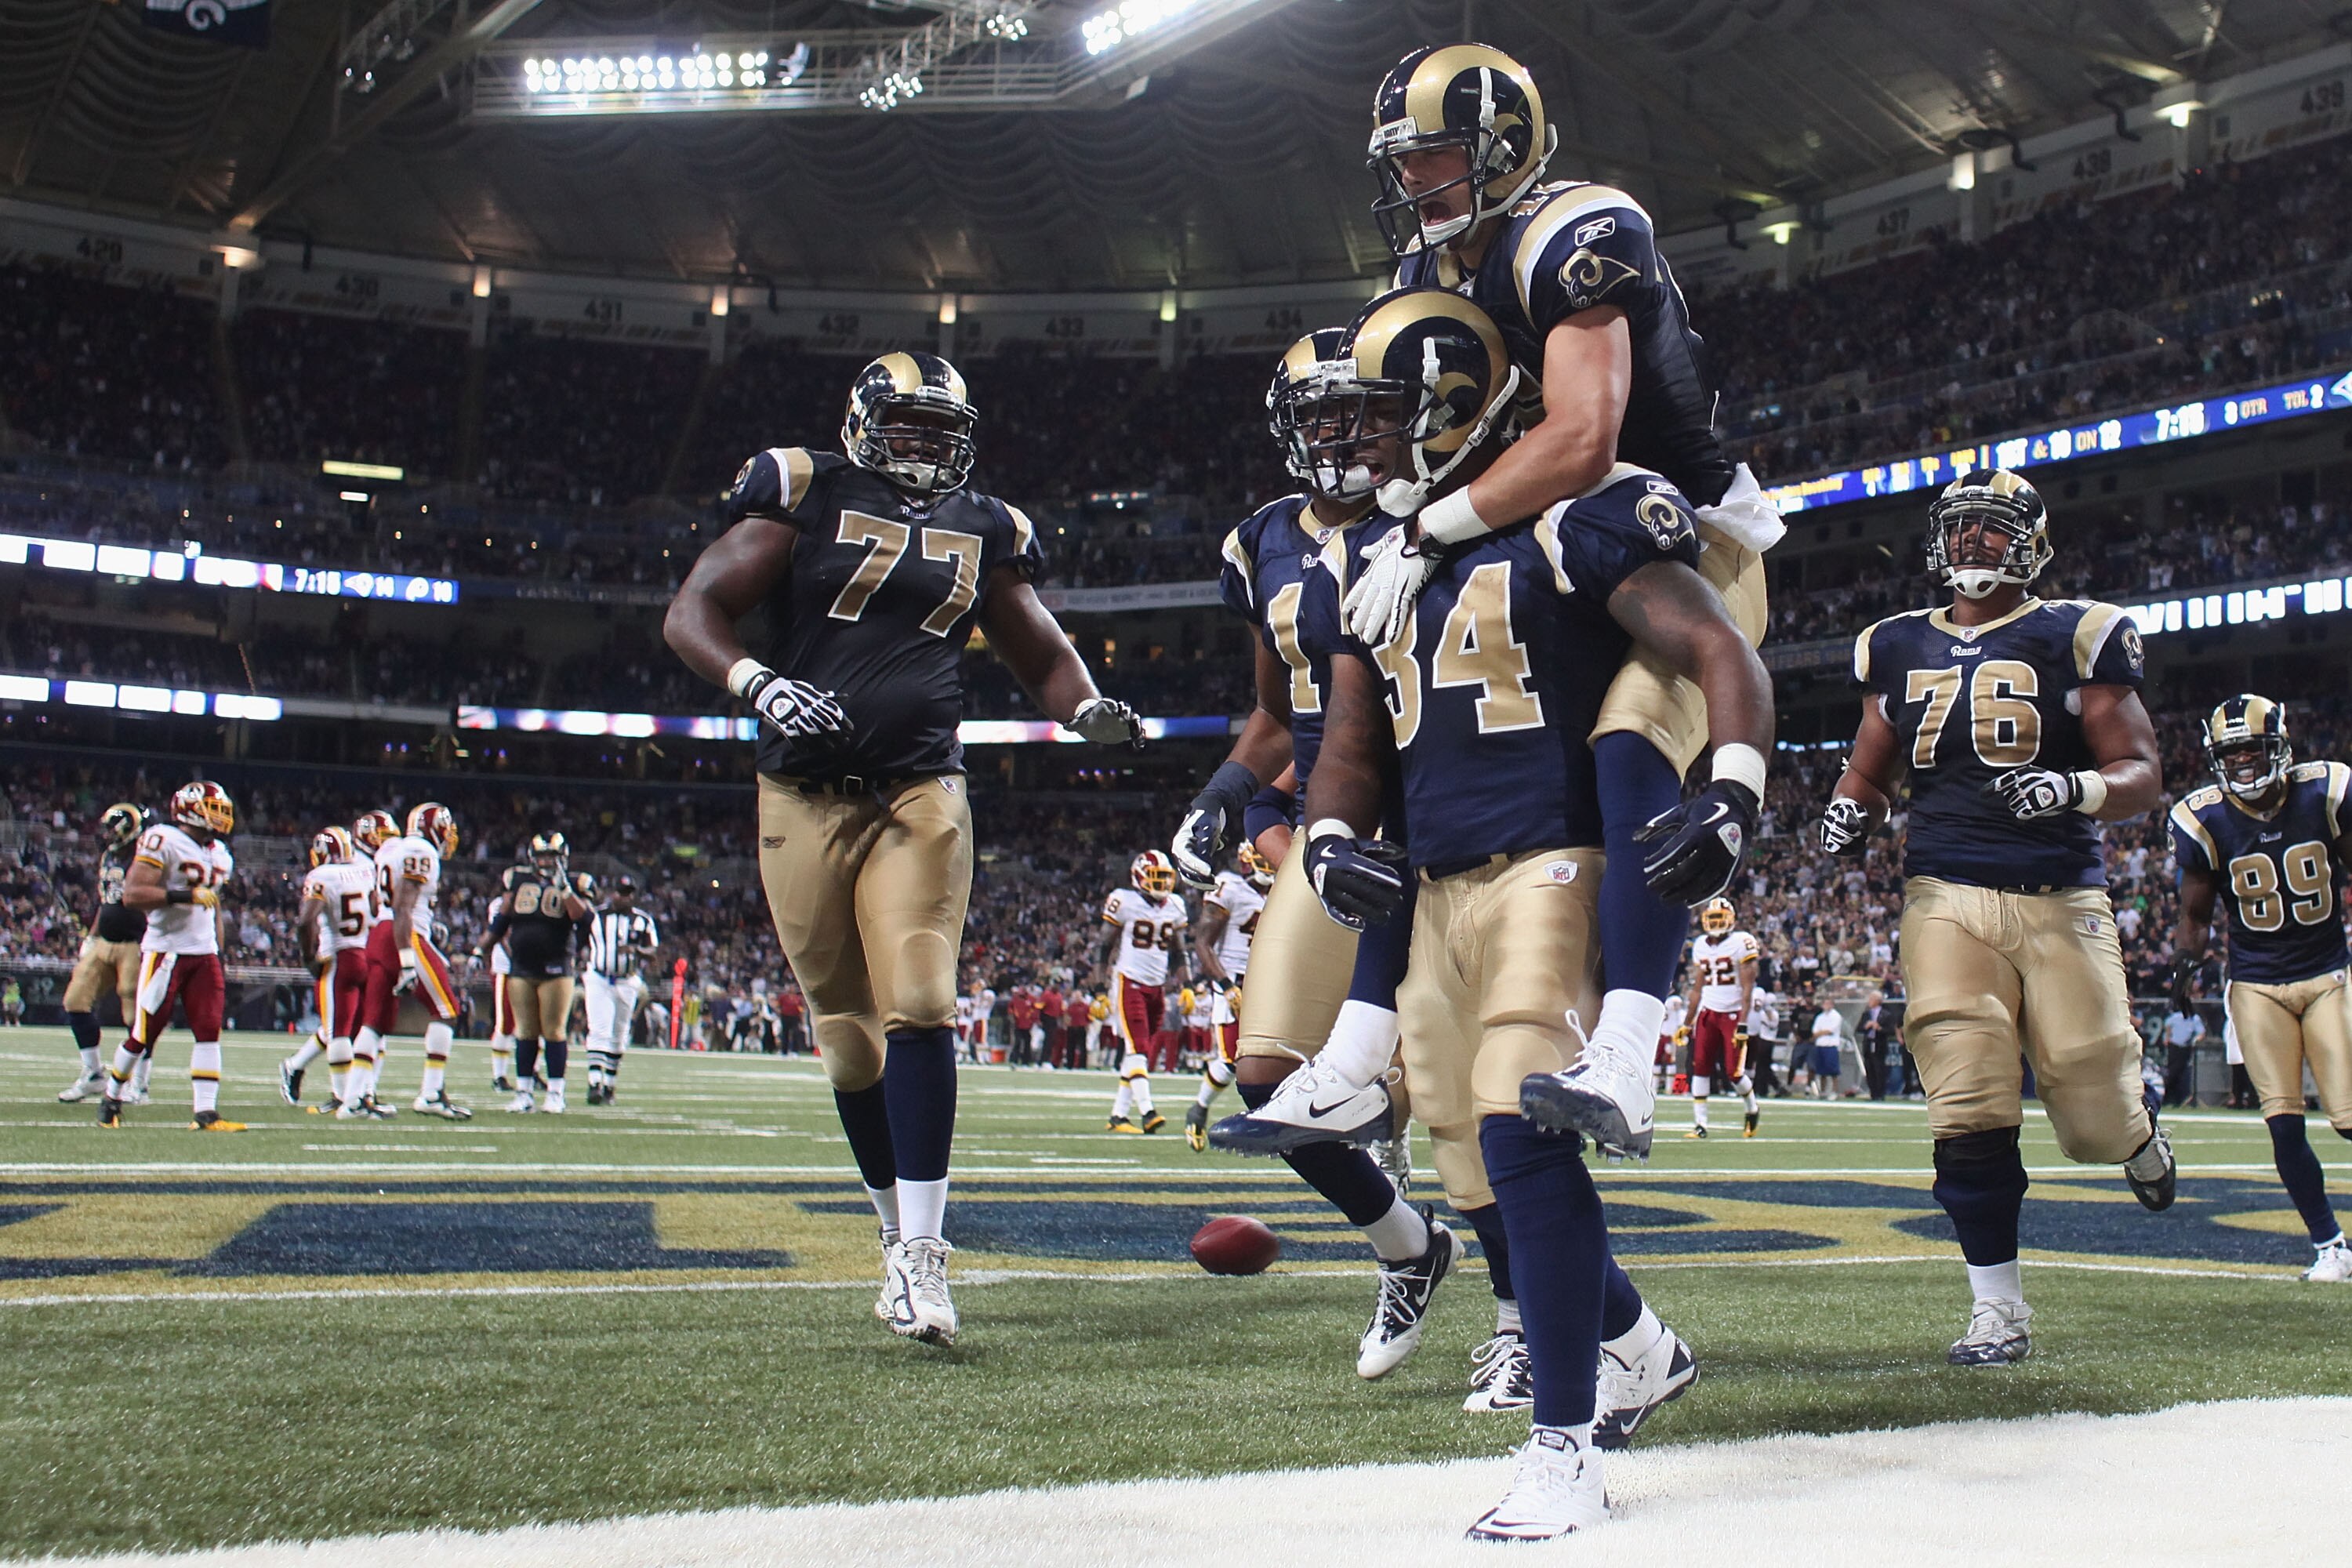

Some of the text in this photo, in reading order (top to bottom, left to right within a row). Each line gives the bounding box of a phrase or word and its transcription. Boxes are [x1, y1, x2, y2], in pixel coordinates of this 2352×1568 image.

[2033, 440, 2049, 459] &
[2075, 430, 2098, 452] ON
[2099, 420, 2122, 451] 12
[2154, 401, 2205, 441] 7:15
[295, 568, 341, 595] 7:15
[828, 510, 982, 637] 77
[1373, 561, 1545, 750] 34
[1951, 645, 1982, 658] Rams
[1905, 660, 2042, 769] 76
[514, 881, 566, 919] 60
[2229, 840, 2332, 932] 89
[1699, 956, 1736, 985] 22
